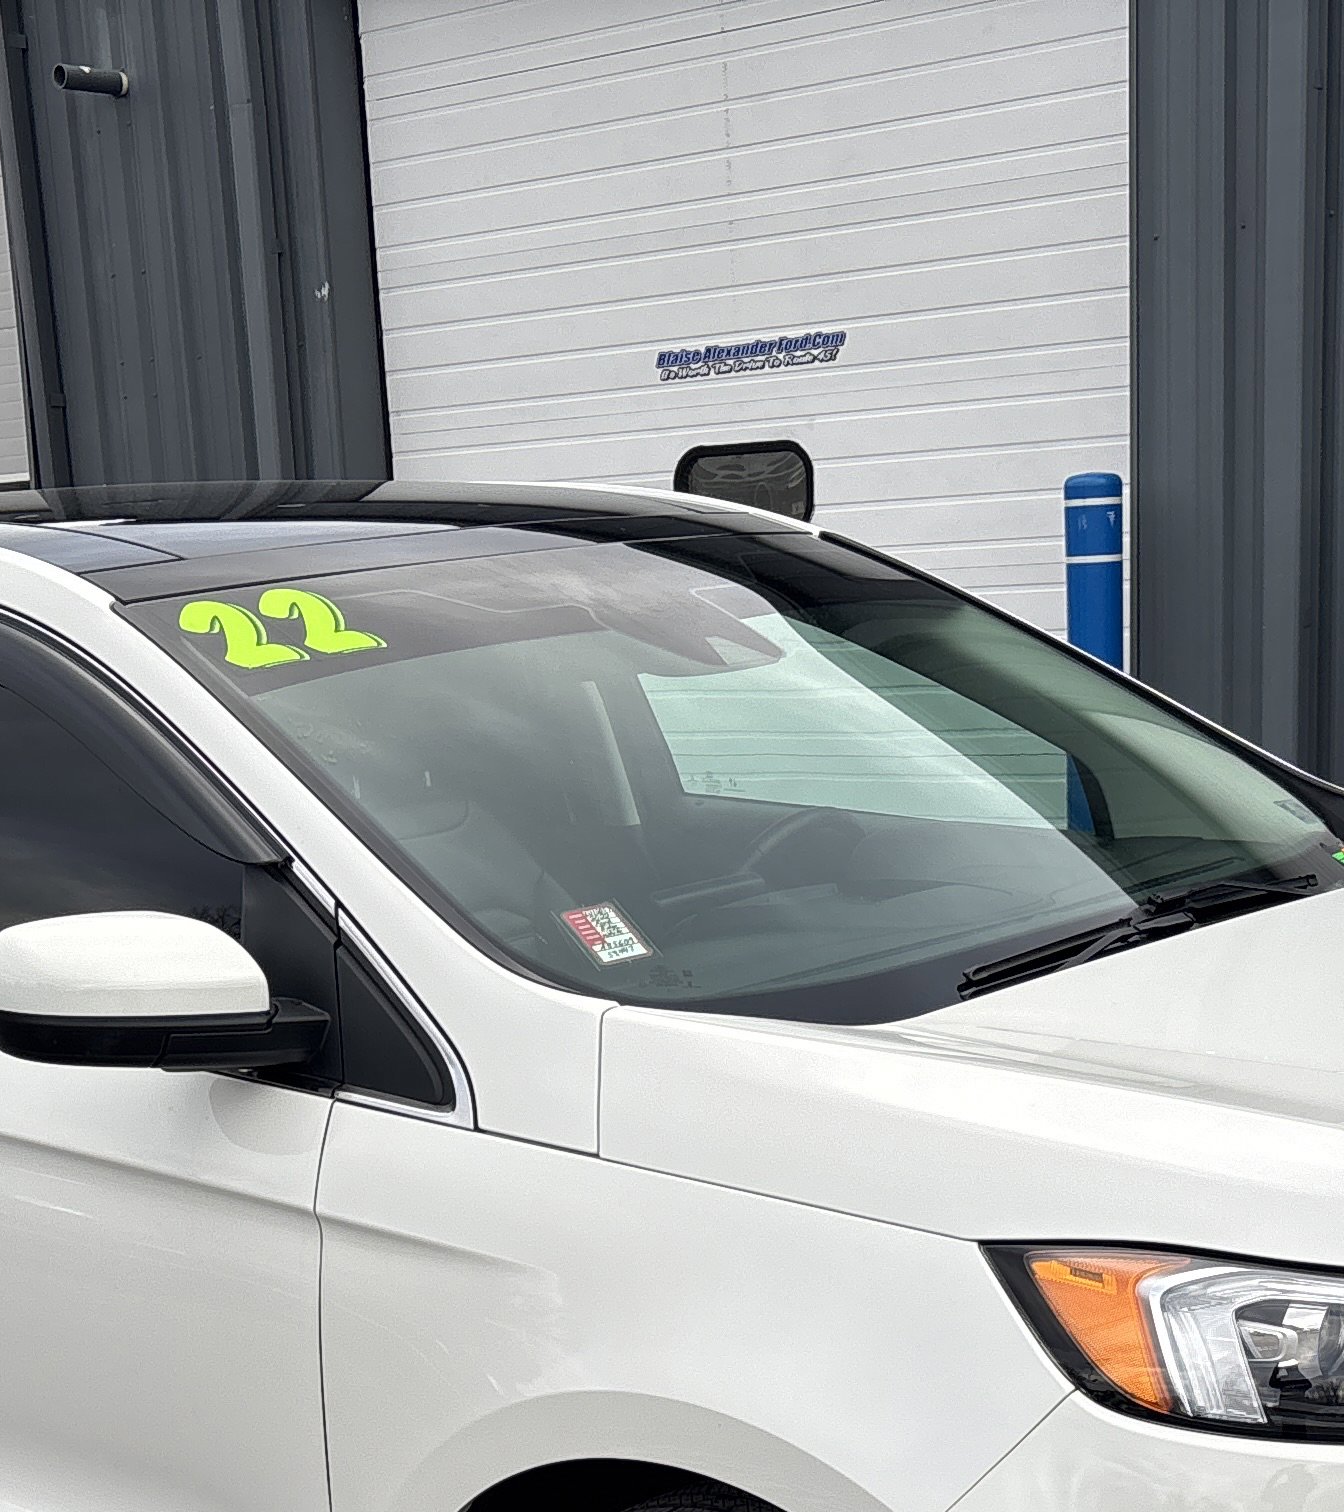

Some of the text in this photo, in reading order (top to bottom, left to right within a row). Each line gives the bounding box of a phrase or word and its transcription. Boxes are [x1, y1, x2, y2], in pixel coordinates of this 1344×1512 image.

[657, 349, 702, 369] Blaise
[701, 340, 777, 363] Alexander
[765, 355, 782, 369] To
[178, 588, 388, 669] 22
